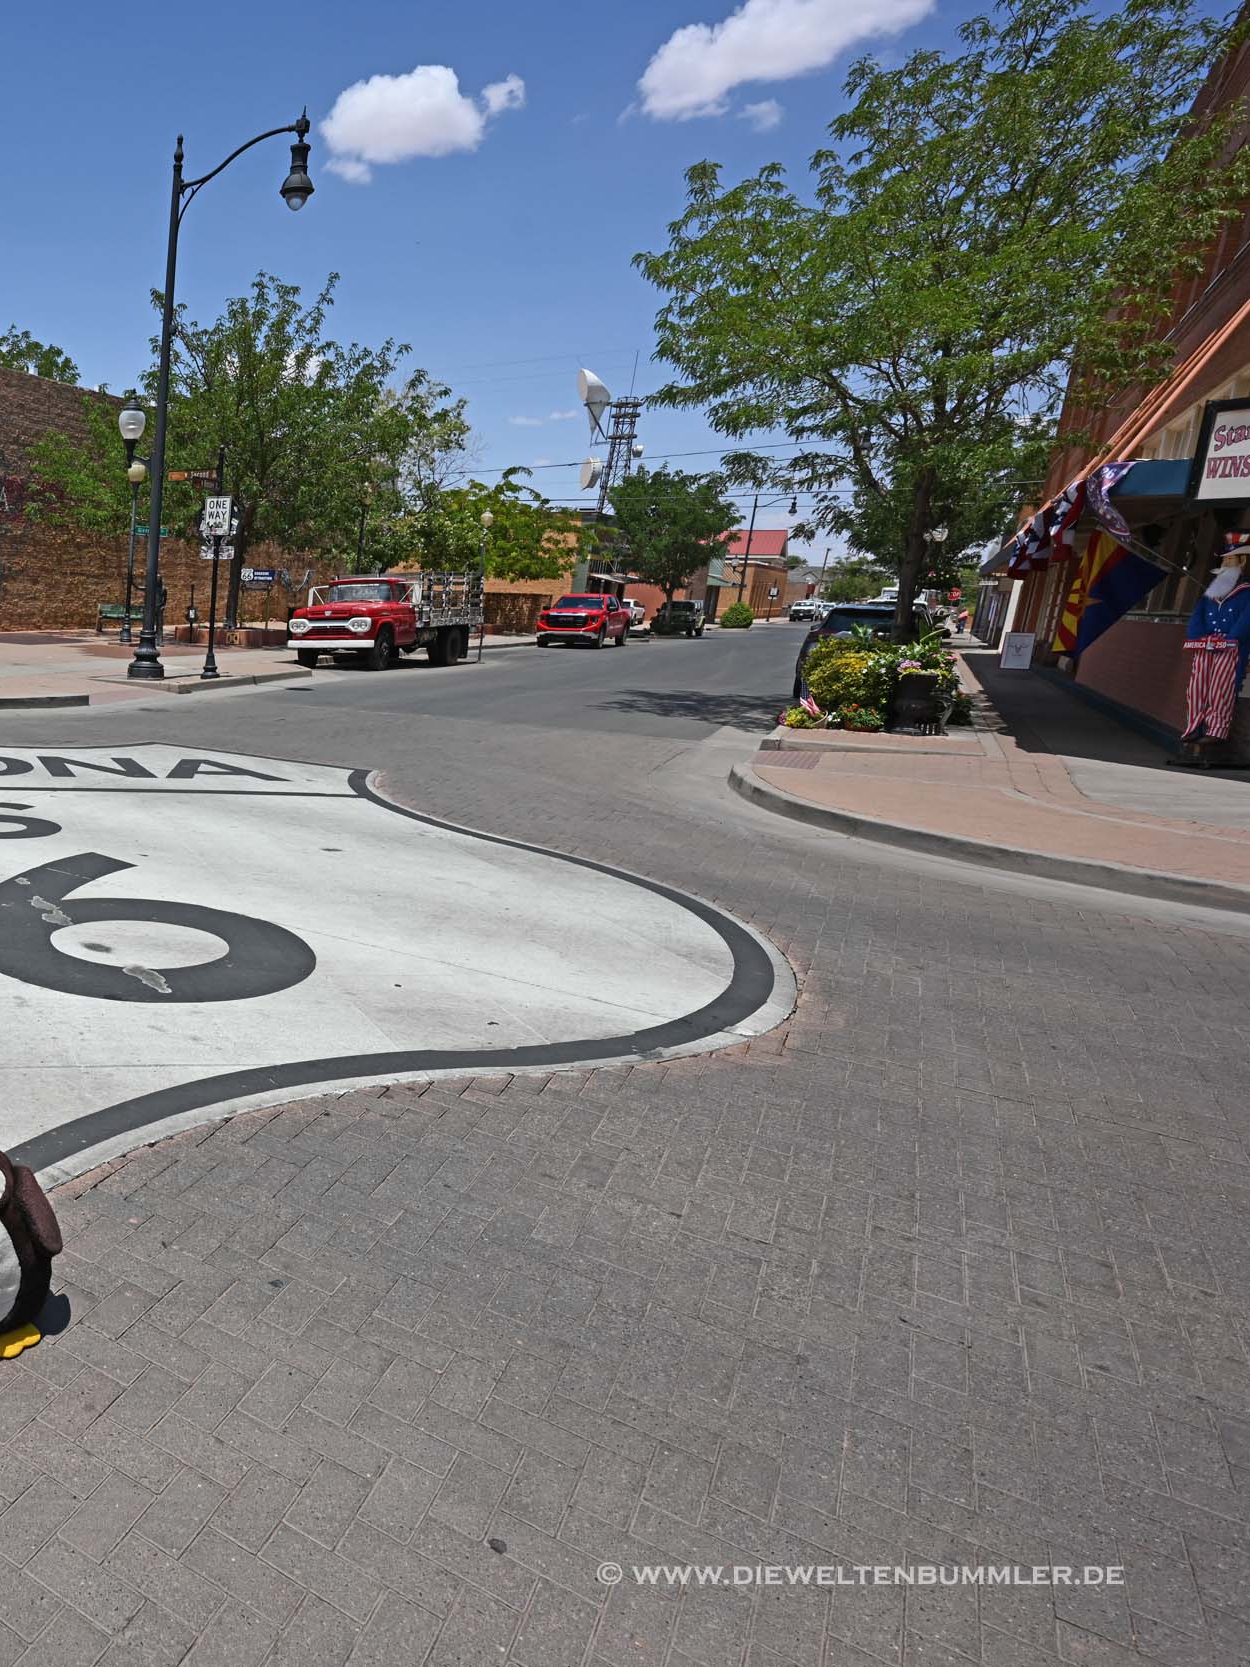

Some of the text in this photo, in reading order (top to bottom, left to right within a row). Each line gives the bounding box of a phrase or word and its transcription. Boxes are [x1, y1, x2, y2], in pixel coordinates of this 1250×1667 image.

[1214, 425, 1250, 452] Sta
[209, 500, 227, 510] ONE
[208, 511, 227, 520] WAY
[1182, 641, 1206, 649] AMERICA
[1215, 641, 1227, 649] 250
